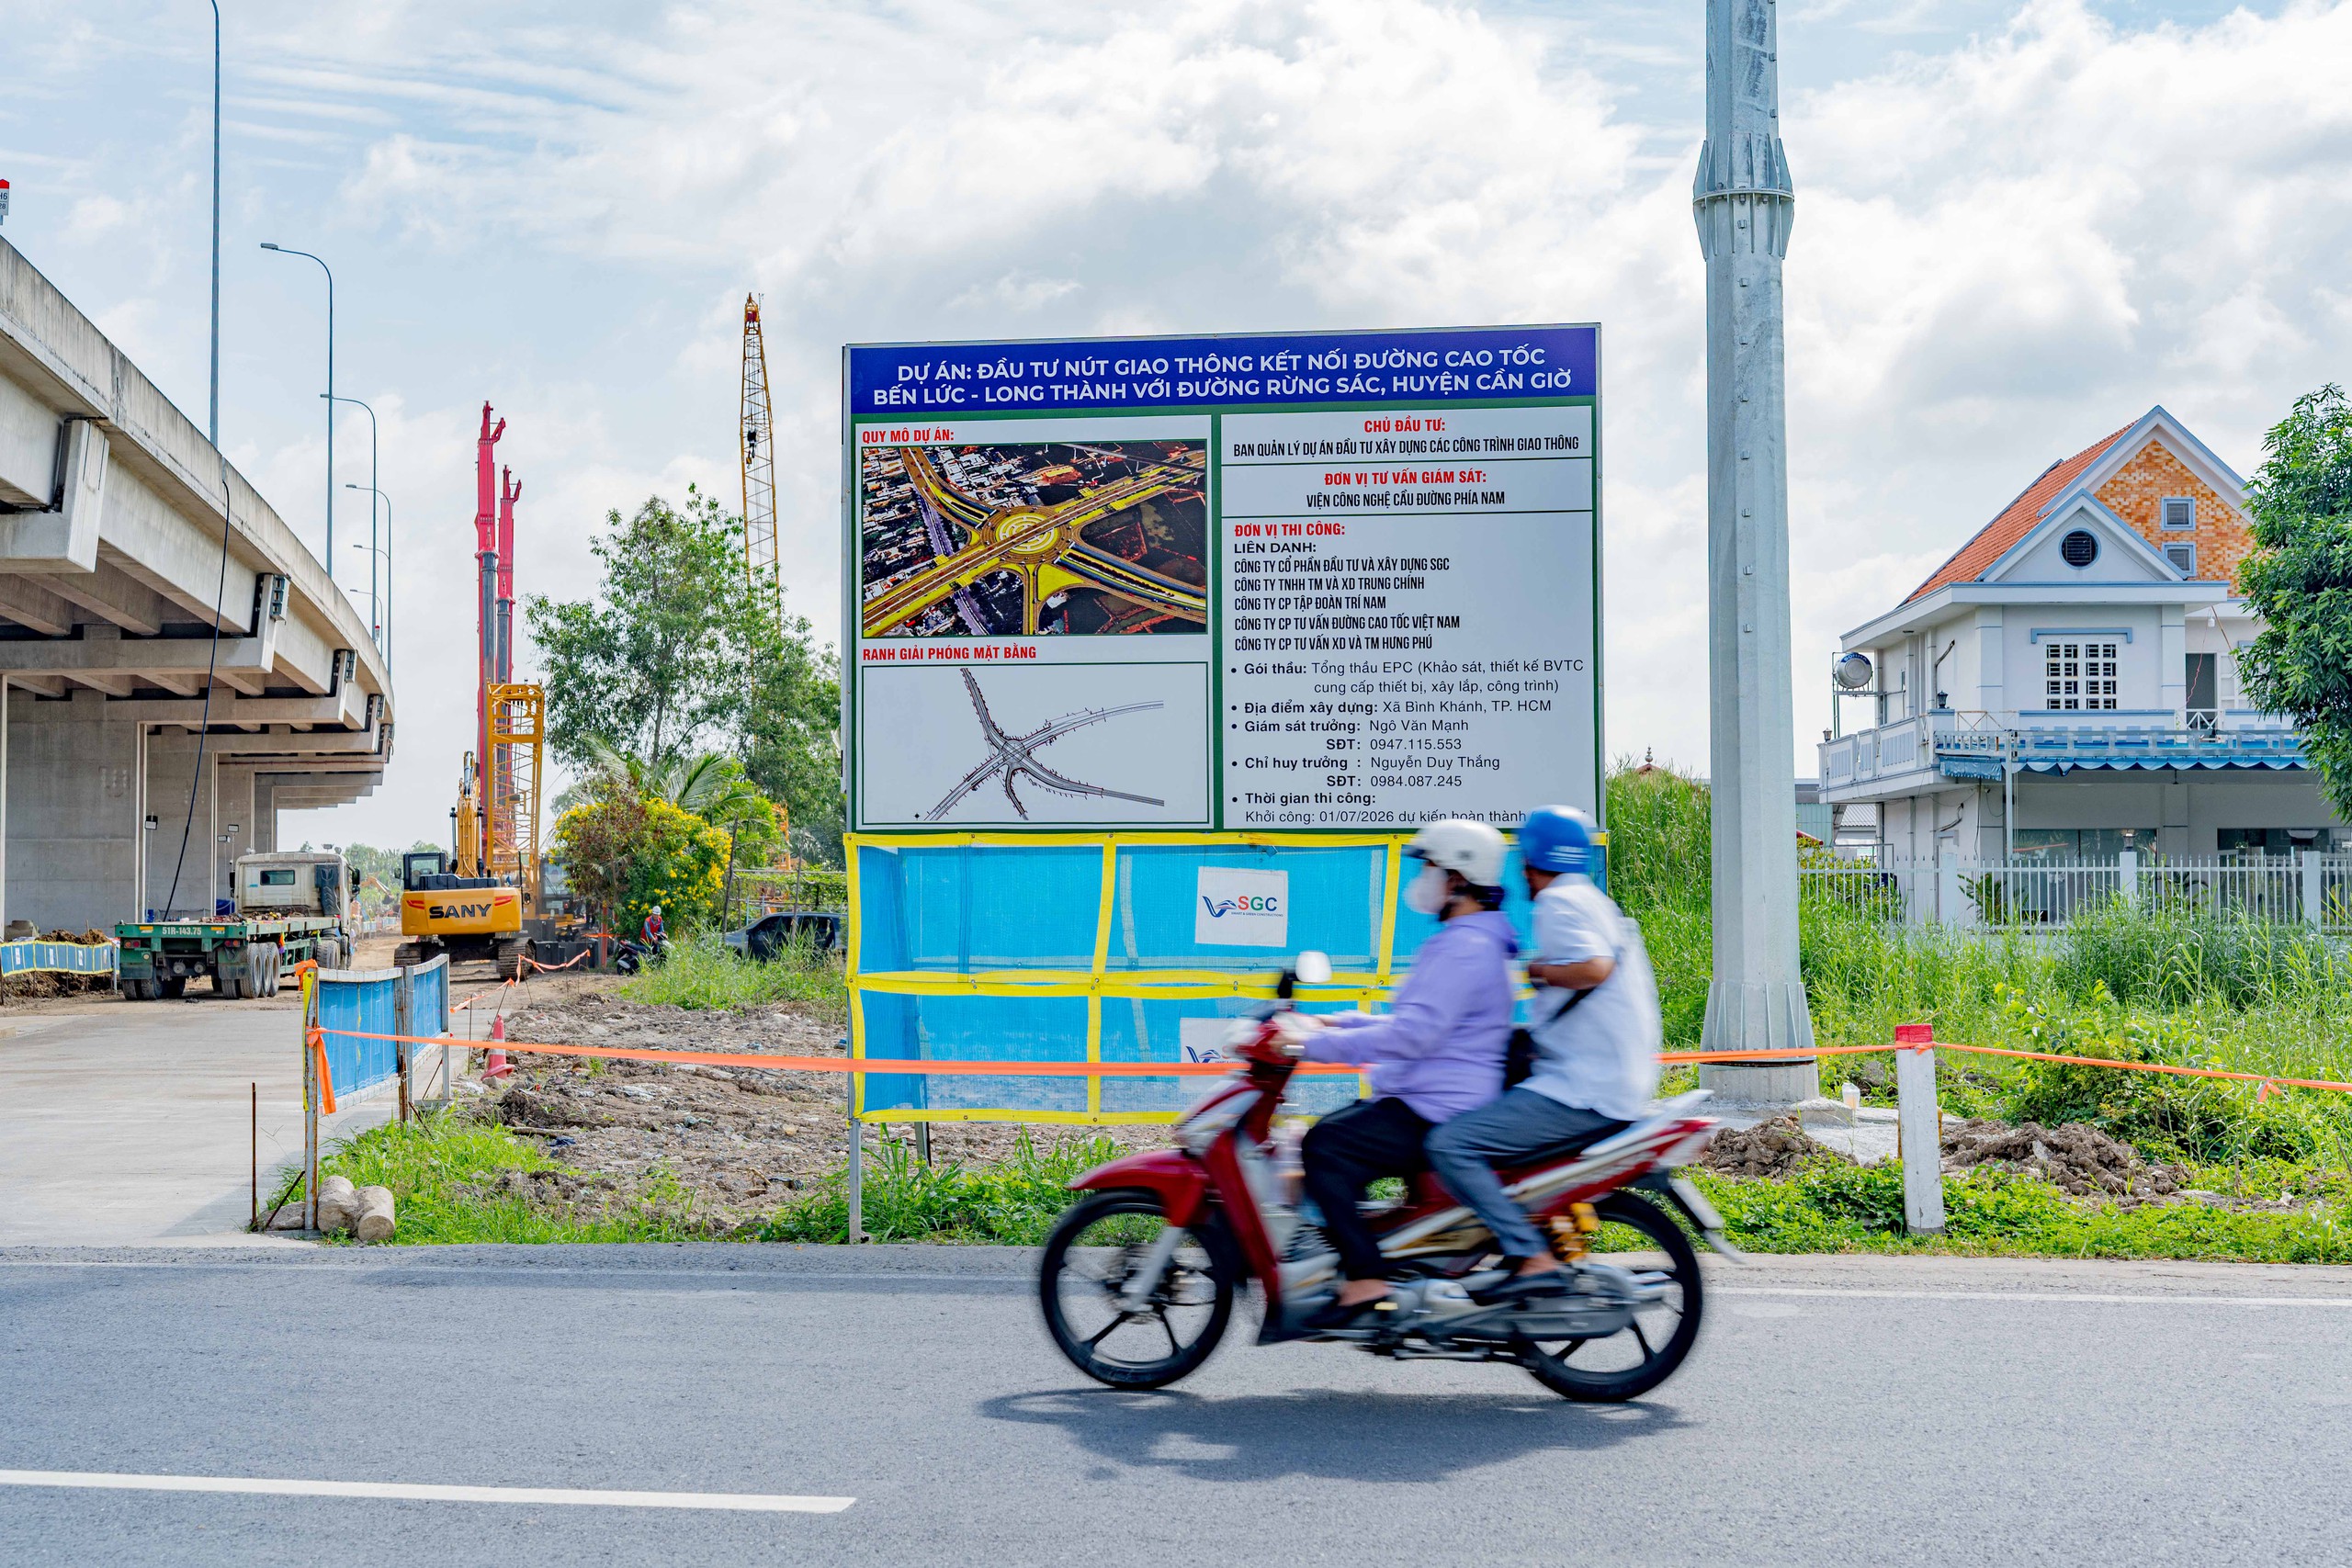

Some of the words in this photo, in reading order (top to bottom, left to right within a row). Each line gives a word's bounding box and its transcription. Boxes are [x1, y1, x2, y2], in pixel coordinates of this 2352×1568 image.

[898, 362, 931, 383] DỰ
[934, 360, 971, 380] ÁN:
[976, 356, 1023, 379] ĐẦU
[1029, 358, 1059, 378] TƯ
[1065, 355, 1109, 377] NÚT
[1114, 357, 1169, 376] GIAO
[1174, 353, 1253, 373] THÔNG
[1260, 349, 1302, 371] KẾT
[1307, 347, 1347, 370] NỐI
[1352, 348, 1438, 369] ĐƯỜNG
[1444, 349, 1493, 367] CAO
[1498, 343, 1545, 366] TỐC
[874, 383, 917, 405] BẾN
[922, 384, 966, 404] LỨC
[985, 385, 1044, 402] LONG
[1049, 379, 1126, 400] THÀNH
[1132, 378, 1170, 399] VỚI
[1176, 377, 1260, 397] ĐƯỜNG
[1267, 375, 1329, 395] RỪNG
[1336, 373, 1385, 395] SÁC,
[1393, 371, 1469, 395] HUYỆN
[1476, 367, 1523, 390] CẦN
[1530, 367, 1571, 389] GIỜ
[1363, 416, 1391, 433] CHỦ
[1394, 415, 1420, 432] ĐẦU
[1424, 417, 1445, 432] TƯ:
[862, 430, 887, 444] QUY
[889, 427, 910, 443] MÔ
[913, 427, 931, 444] DỰ
[933, 426, 954, 441] ÁN:
[1233, 443, 1254, 457] BAN
[1257, 439, 1284, 457] QUẢN
[1287, 440, 1300, 456] LÝ
[1303, 441, 1317, 457] DỰ
[1318, 439, 1333, 455] ÁN
[1335, 437, 1357, 455] ĐẦU
[1359, 440, 1373, 455] TƯ
[1374, 438, 1396, 454] XÂY
[1398, 439, 1427, 456] DỰNG
[1430, 436, 1450, 453] CÁC
[1453, 436, 1480, 453] CÔNG
[1483, 435, 1514, 452] TRÌNH
[1517, 437, 1542, 451] GIAO
[1544, 434, 1579, 450] THÔNG
[1324, 471, 1351, 486] ĐƠN
[1354, 472, 1367, 488] VỊ
[1371, 470, 1389, 485] TƯ
[1391, 468, 1417, 484] VẤN
[1421, 468, 1454, 484] GIÁM
[1458, 468, 1487, 483] SÁT:
[1306, 491, 1330, 510] VIỆN
[1332, 491, 1361, 507] CÔNG
[1363, 491, 1391, 509] NGHỆ
[1393, 489, 1414, 506] CẦU
[1416, 490, 1452, 506] ĐƯỜNG
[1453, 489, 1478, 505] PHÍA
[1481, 491, 1505, 504] NAM
[1234, 523, 1261, 537] ĐƠN
[1264, 524, 1277, 539] VỊ
[1281, 523, 1302, 536] THI
[1306, 521, 1345, 536] CÔNG:
[1234, 558, 1261, 573] CÔNG
[1262, 559, 1276, 573] TY
[1278, 556, 1292, 573] CỔ
[1294, 556, 1320, 572] PHẦN
[1323, 555, 1343, 572] ĐẦU
[1345, 558, 1359, 572] TƯ
[1361, 556, 1375, 571] VÀ
[1377, 556, 1398, 571] XÂY
[1400, 558, 1428, 573] DỰNG
[1430, 557, 1450, 570] SGC
[1235, 615, 1261, 631] CÔNG
[1262, 617, 1276, 630] TY
[1278, 617, 1292, 630] CP
[1293, 616, 1306, 630] TƯ
[1308, 613, 1329, 630] VẤN
[1331, 614, 1365, 629] ĐƯỜNG
[1367, 615, 1388, 629] CAO
[1389, 612, 1409, 629] TỐC
[1411, 613, 1434, 631] VIỆT
[1436, 615, 1460, 628] NAM
[863, 648, 896, 660] RANH
[899, 644, 923, 660] GIẢI
[928, 645, 969, 660] PHÓNG
[973, 644, 1000, 661] MẶT
[1003, 642, 1036, 659] BẰNG
[1244, 662, 1268, 674] Gói
[1272, 660, 1306, 674] thầu:
[1311, 660, 1345, 677] Tổng
[1349, 660, 1377, 673] thầu
[1383, 660, 1413, 673] EPC
[1418, 660, 1458, 675] (Khảo
[1462, 660, 1486, 673] sát,
[1489, 659, 1519, 672] thiết
[1523, 658, 1539, 672] kế
[1544, 659, 1584, 671] BVTC
[1314, 683, 1346, 695] cung
[1350, 679, 1374, 695] cấp
[1378, 679, 1408, 693] thiết
[1411, 681, 1427, 694] bị,
[1431, 680, 1454, 695] xây
[1459, 678, 1483, 694] lắp,
[1487, 680, 1520, 694] công
[1523, 679, 1559, 694] trình)
[1244, 702, 1267, 716] Địa
[1271, 698, 1305, 714] điểm
[1309, 701, 1333, 716] xây
[1338, 701, 1377, 716] dựng:
[1383, 701, 1401, 713] Xã
[1405, 700, 1435, 713] Bình
[1440, 700, 1487, 713] Khánh,
[1490, 700, 1512, 712] TP.
[1517, 699, 1551, 712] HCM
[1244, 720, 1280, 732] Giám
[1284, 719, 1306, 732] sát
[1309, 718, 1361, 734] trưởng:
[1369, 719, 1396, 734] Ngô
[1400, 719, 1427, 731] Văn
[1431, 719, 1468, 733] Mạnh
[1326, 738, 1361, 750] SĐT:
[1370, 738, 1462, 750] 0947.115.553
[1244, 755, 1269, 769] Chỉ
[1272, 757, 1298, 772] huy
[1302, 755, 1348, 771] trưởng
[1371, 754, 1421, 771] Nguyễn
[1427, 756, 1453, 771] Duy
[1457, 754, 1499, 771] Thắng
[1244, 792, 1275, 804] Thời
[1280, 792, 1309, 807] gian
[1314, 792, 1332, 804] thi
[1336, 792, 1375, 807] công:
[1246, 809, 1274, 822] Khởi
[1279, 810, 1315, 825] công:
[1319, 810, 1394, 822] 01/07/2026
[1398, 810, 1416, 824] dự
[1419, 808, 1447, 822] kiến
[1488, 809, 1529, 822] thành
[429, 904, 492, 919] SANY
[1238, 896, 1277, 911] SGC
